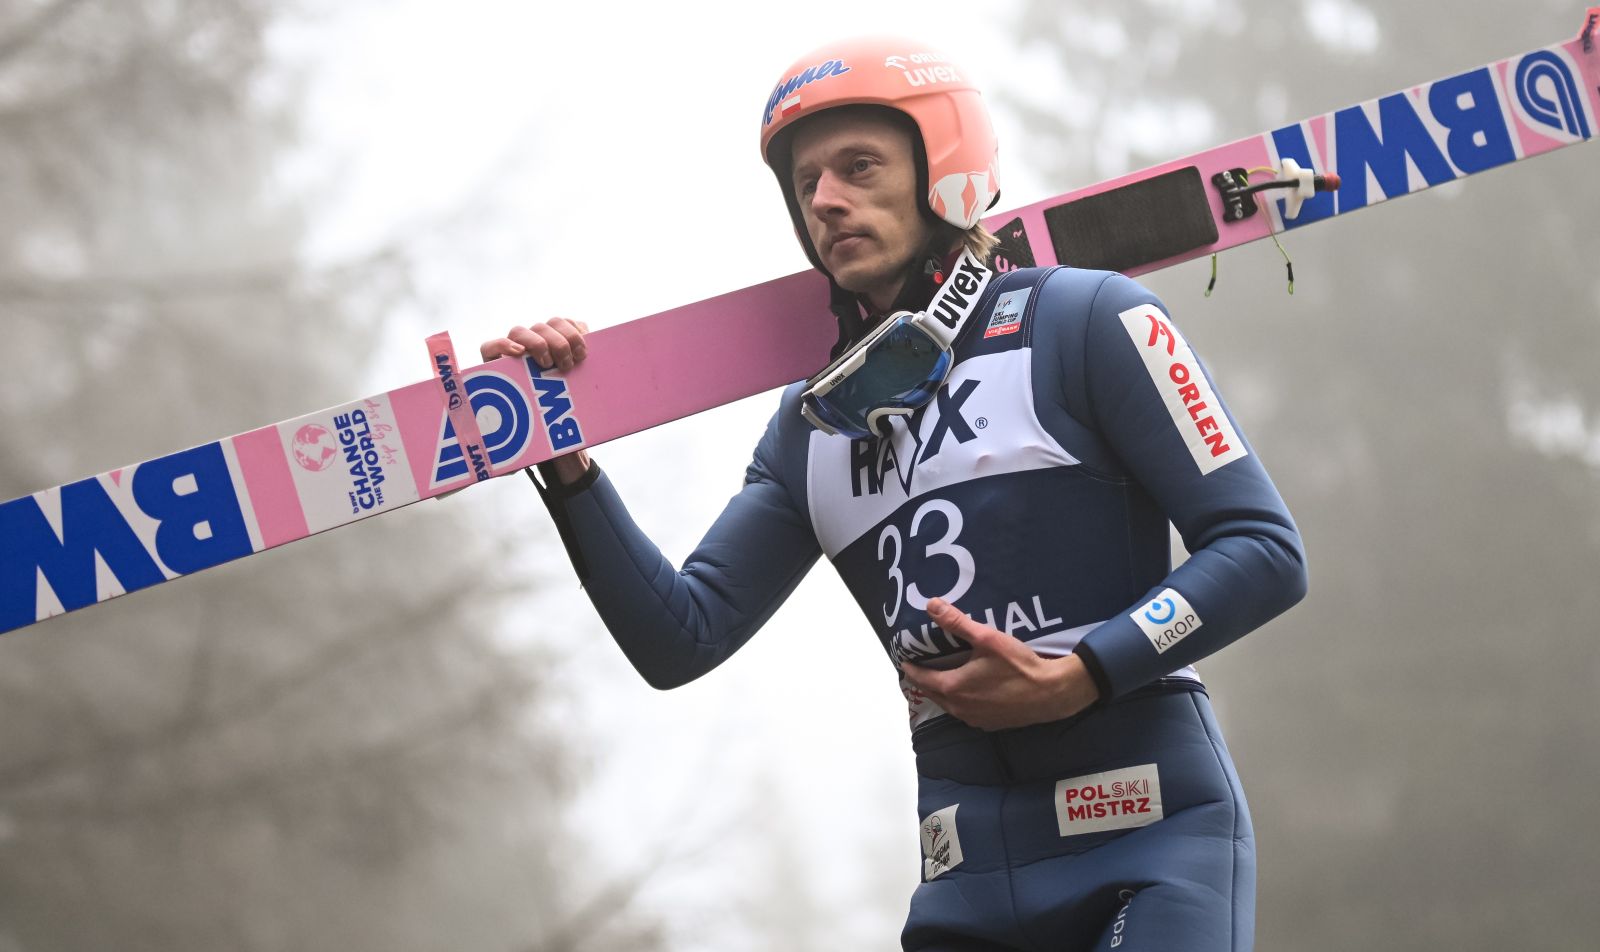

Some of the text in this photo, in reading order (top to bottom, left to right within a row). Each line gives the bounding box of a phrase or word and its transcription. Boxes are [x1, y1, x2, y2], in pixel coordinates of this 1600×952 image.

[903, 66, 961, 87] uvex
[933, 256, 986, 329] uvex
[436, 354, 456, 392] BWT
[829, 372, 846, 386] uvex
[1169, 362, 1230, 457] ORLEN
[334, 413, 375, 509] CHANGE
[352, 409, 385, 506] THE WORLD
[467, 444, 490, 482] BWT
[878, 499, 976, 628] 33
[1153, 614, 1196, 650] KROP
[1065, 779, 1149, 803] POLSKI
[1067, 797, 1151, 821] MISTRZ
